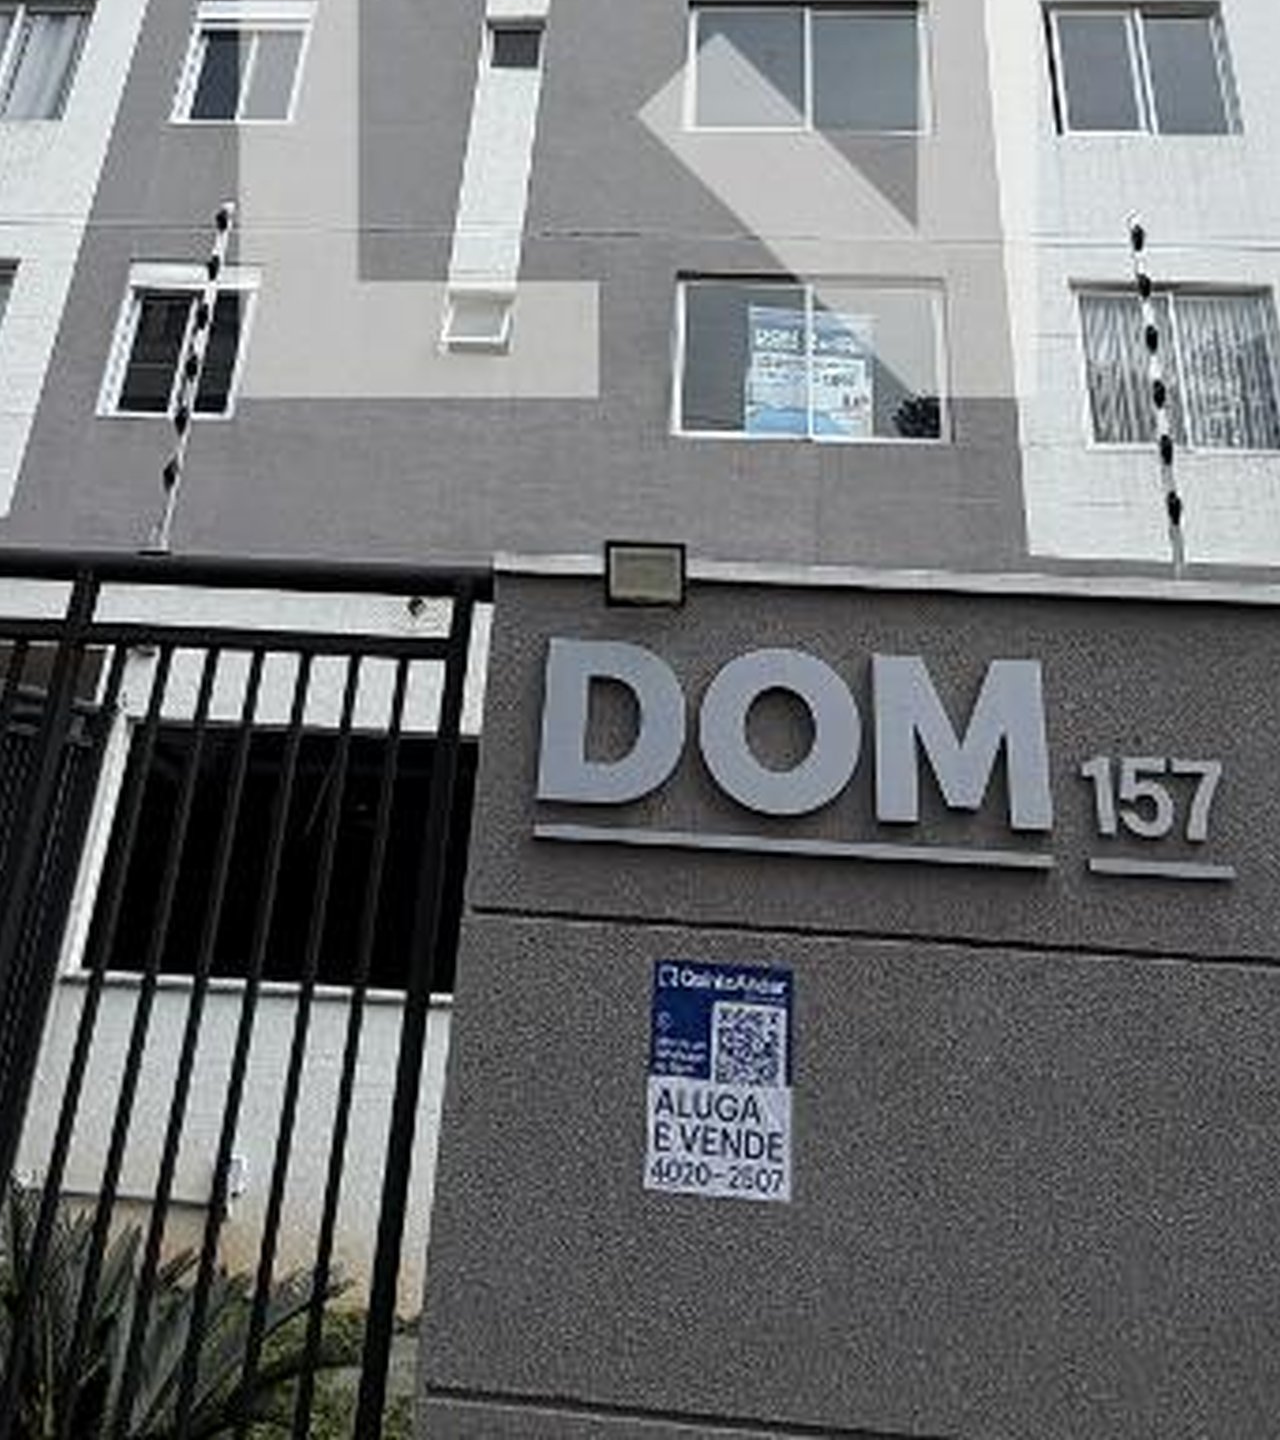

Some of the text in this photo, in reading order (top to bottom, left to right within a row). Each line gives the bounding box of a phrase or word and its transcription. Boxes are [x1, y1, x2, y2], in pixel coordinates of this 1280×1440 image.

[536, 636, 1223, 842] DOM 157
[654, 1088, 762, 1124] ALUGA
[653, 1121, 783, 1163] E VENDE
